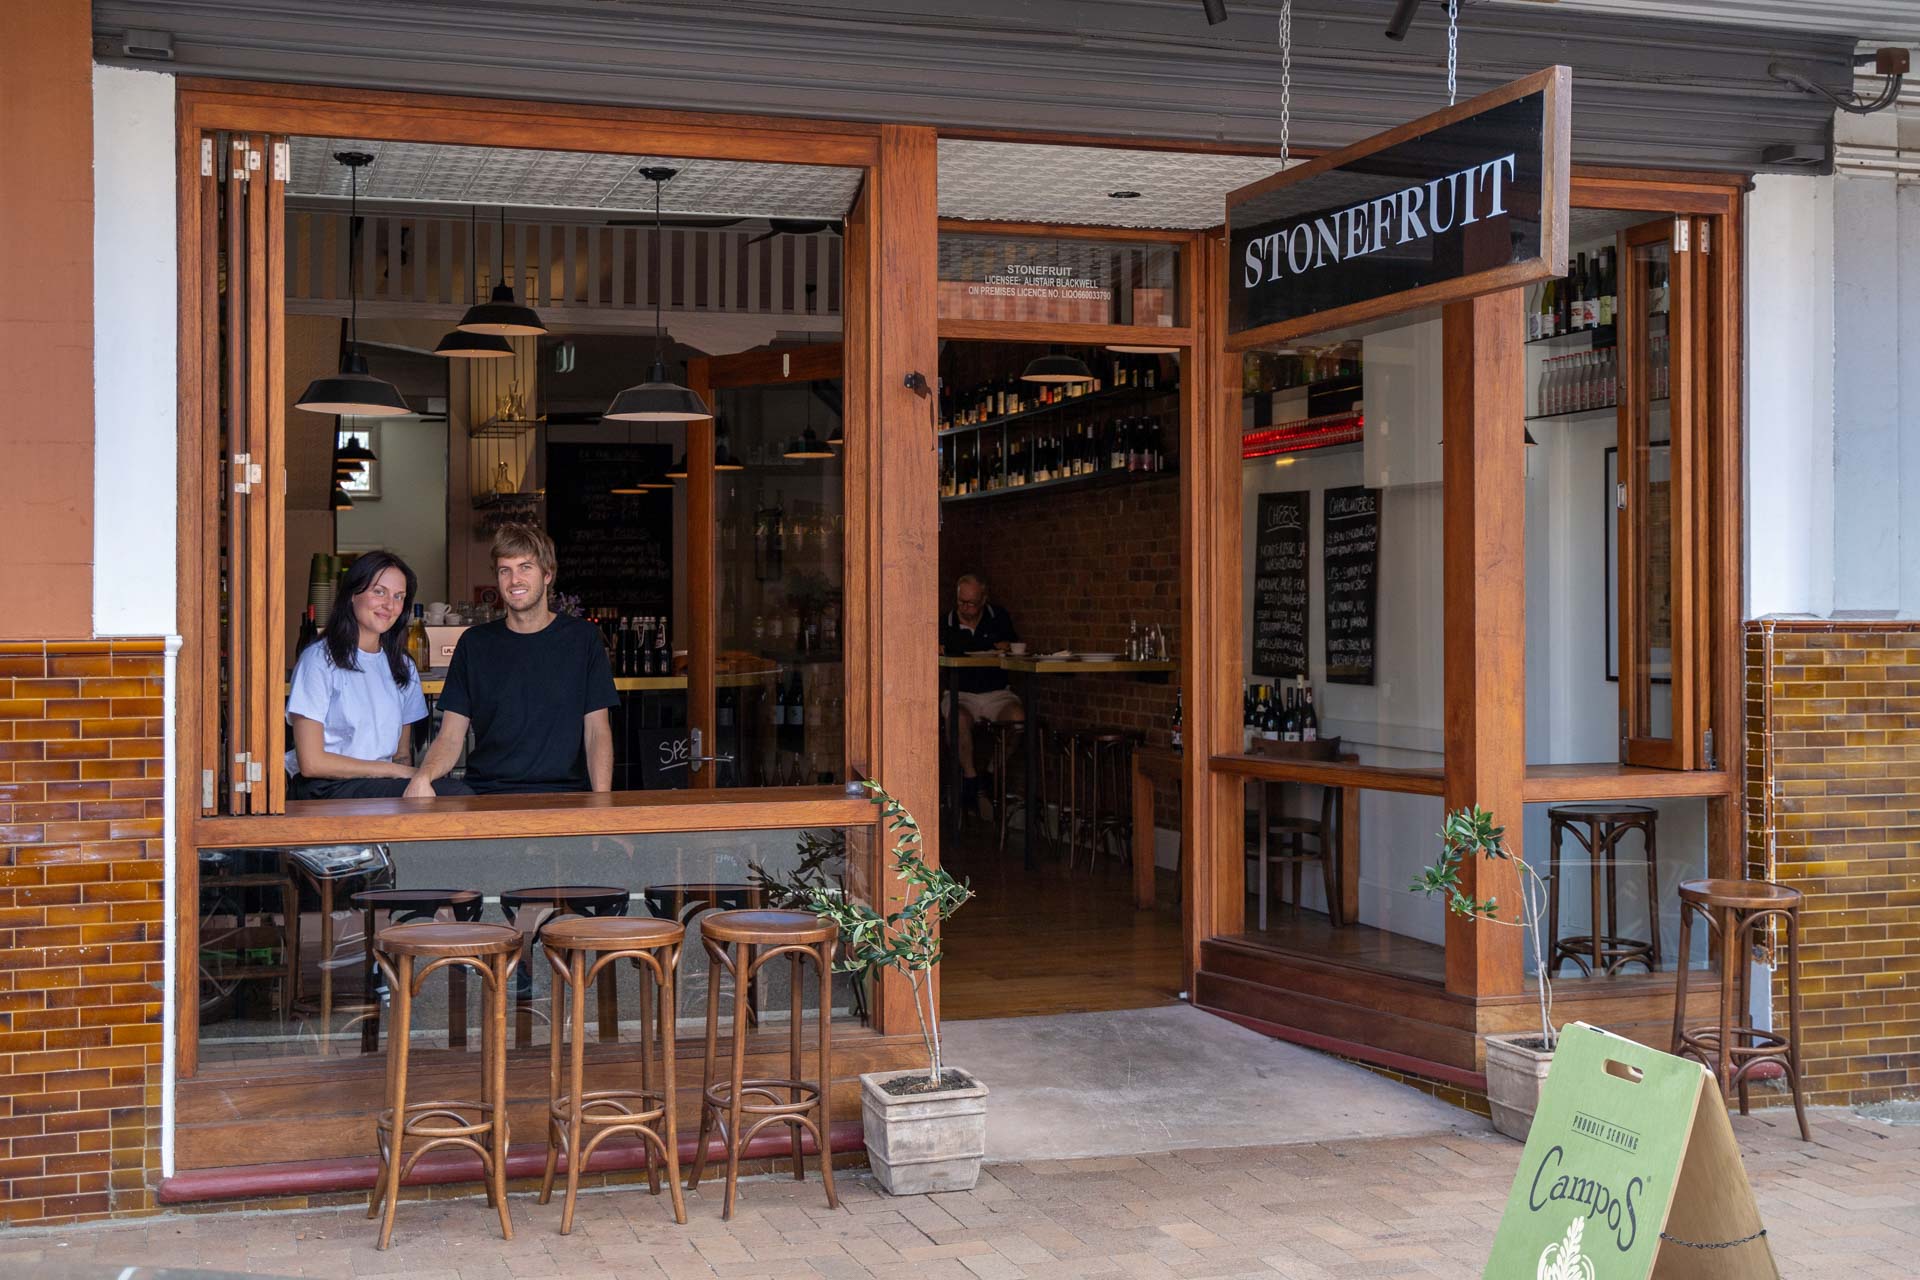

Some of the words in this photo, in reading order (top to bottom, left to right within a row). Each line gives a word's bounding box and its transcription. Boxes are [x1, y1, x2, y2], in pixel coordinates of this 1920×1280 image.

[1244, 153, 1516, 288] STONEFRUIT
[1007, 265, 1072, 276] STONEFRUIT
[984, 275, 1022, 286] LICENSEE:
[1024, 277, 1055, 287] ALISTAIR
[1056, 278, 1098, 289] BLACKWELL
[969, 286, 979, 295] ON
[980, 287, 1016, 297] PREMISES
[1017, 288, 1048, 298] LICENCE
[1048, 289, 1061, 298] NO.
[1572, 1115, 1605, 1138] PROUDLY
[1606, 1127, 1640, 1151] SERVING
